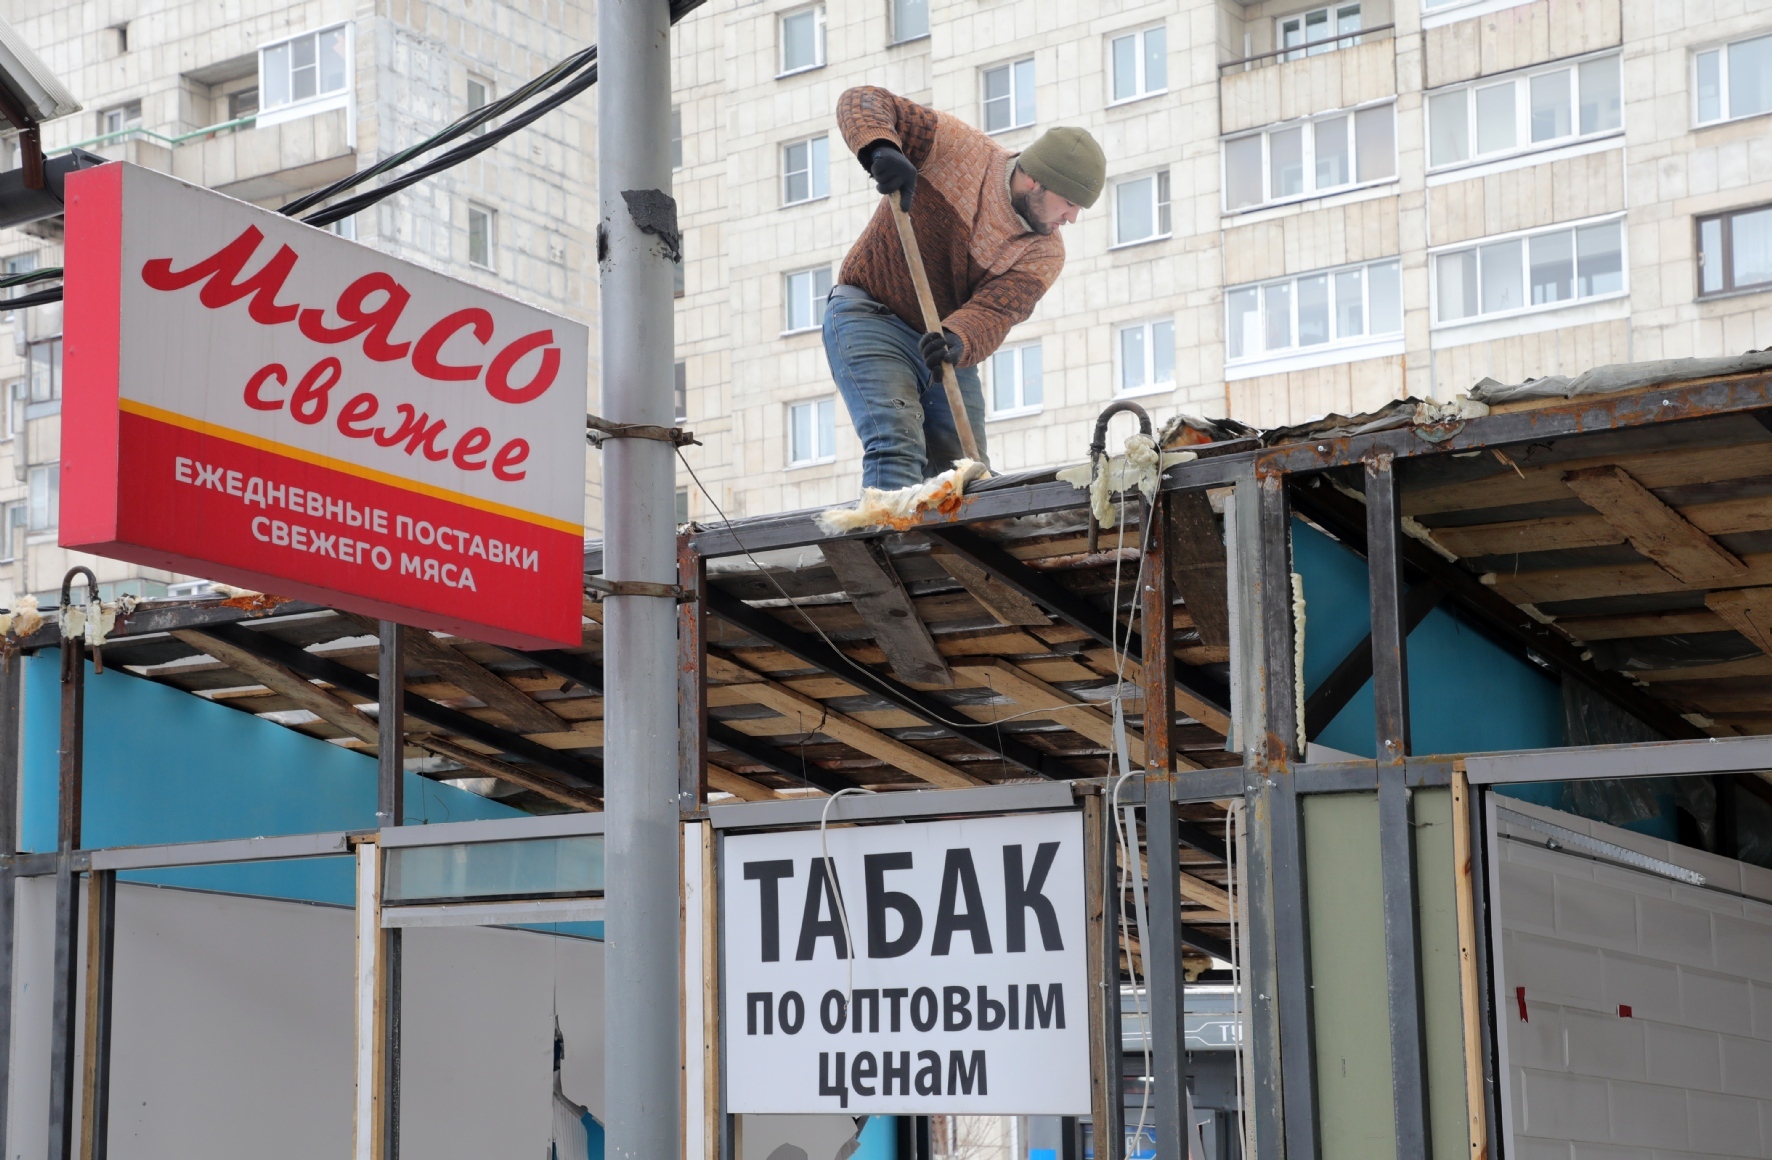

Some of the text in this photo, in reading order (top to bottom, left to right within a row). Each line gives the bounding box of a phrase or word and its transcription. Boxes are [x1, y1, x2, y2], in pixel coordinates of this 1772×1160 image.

[243, 357, 531, 483] свежее
[175, 456, 539, 573] ЕЖЕДНЕВНЫЕ ПОСТАВКИ
[251, 516, 477, 592] СВЕЖЕГО МЯСА
[743, 841, 1065, 962] ТАБАК
[746, 983, 1066, 1035] по оптовым
[818, 1050, 988, 1108] ценам
